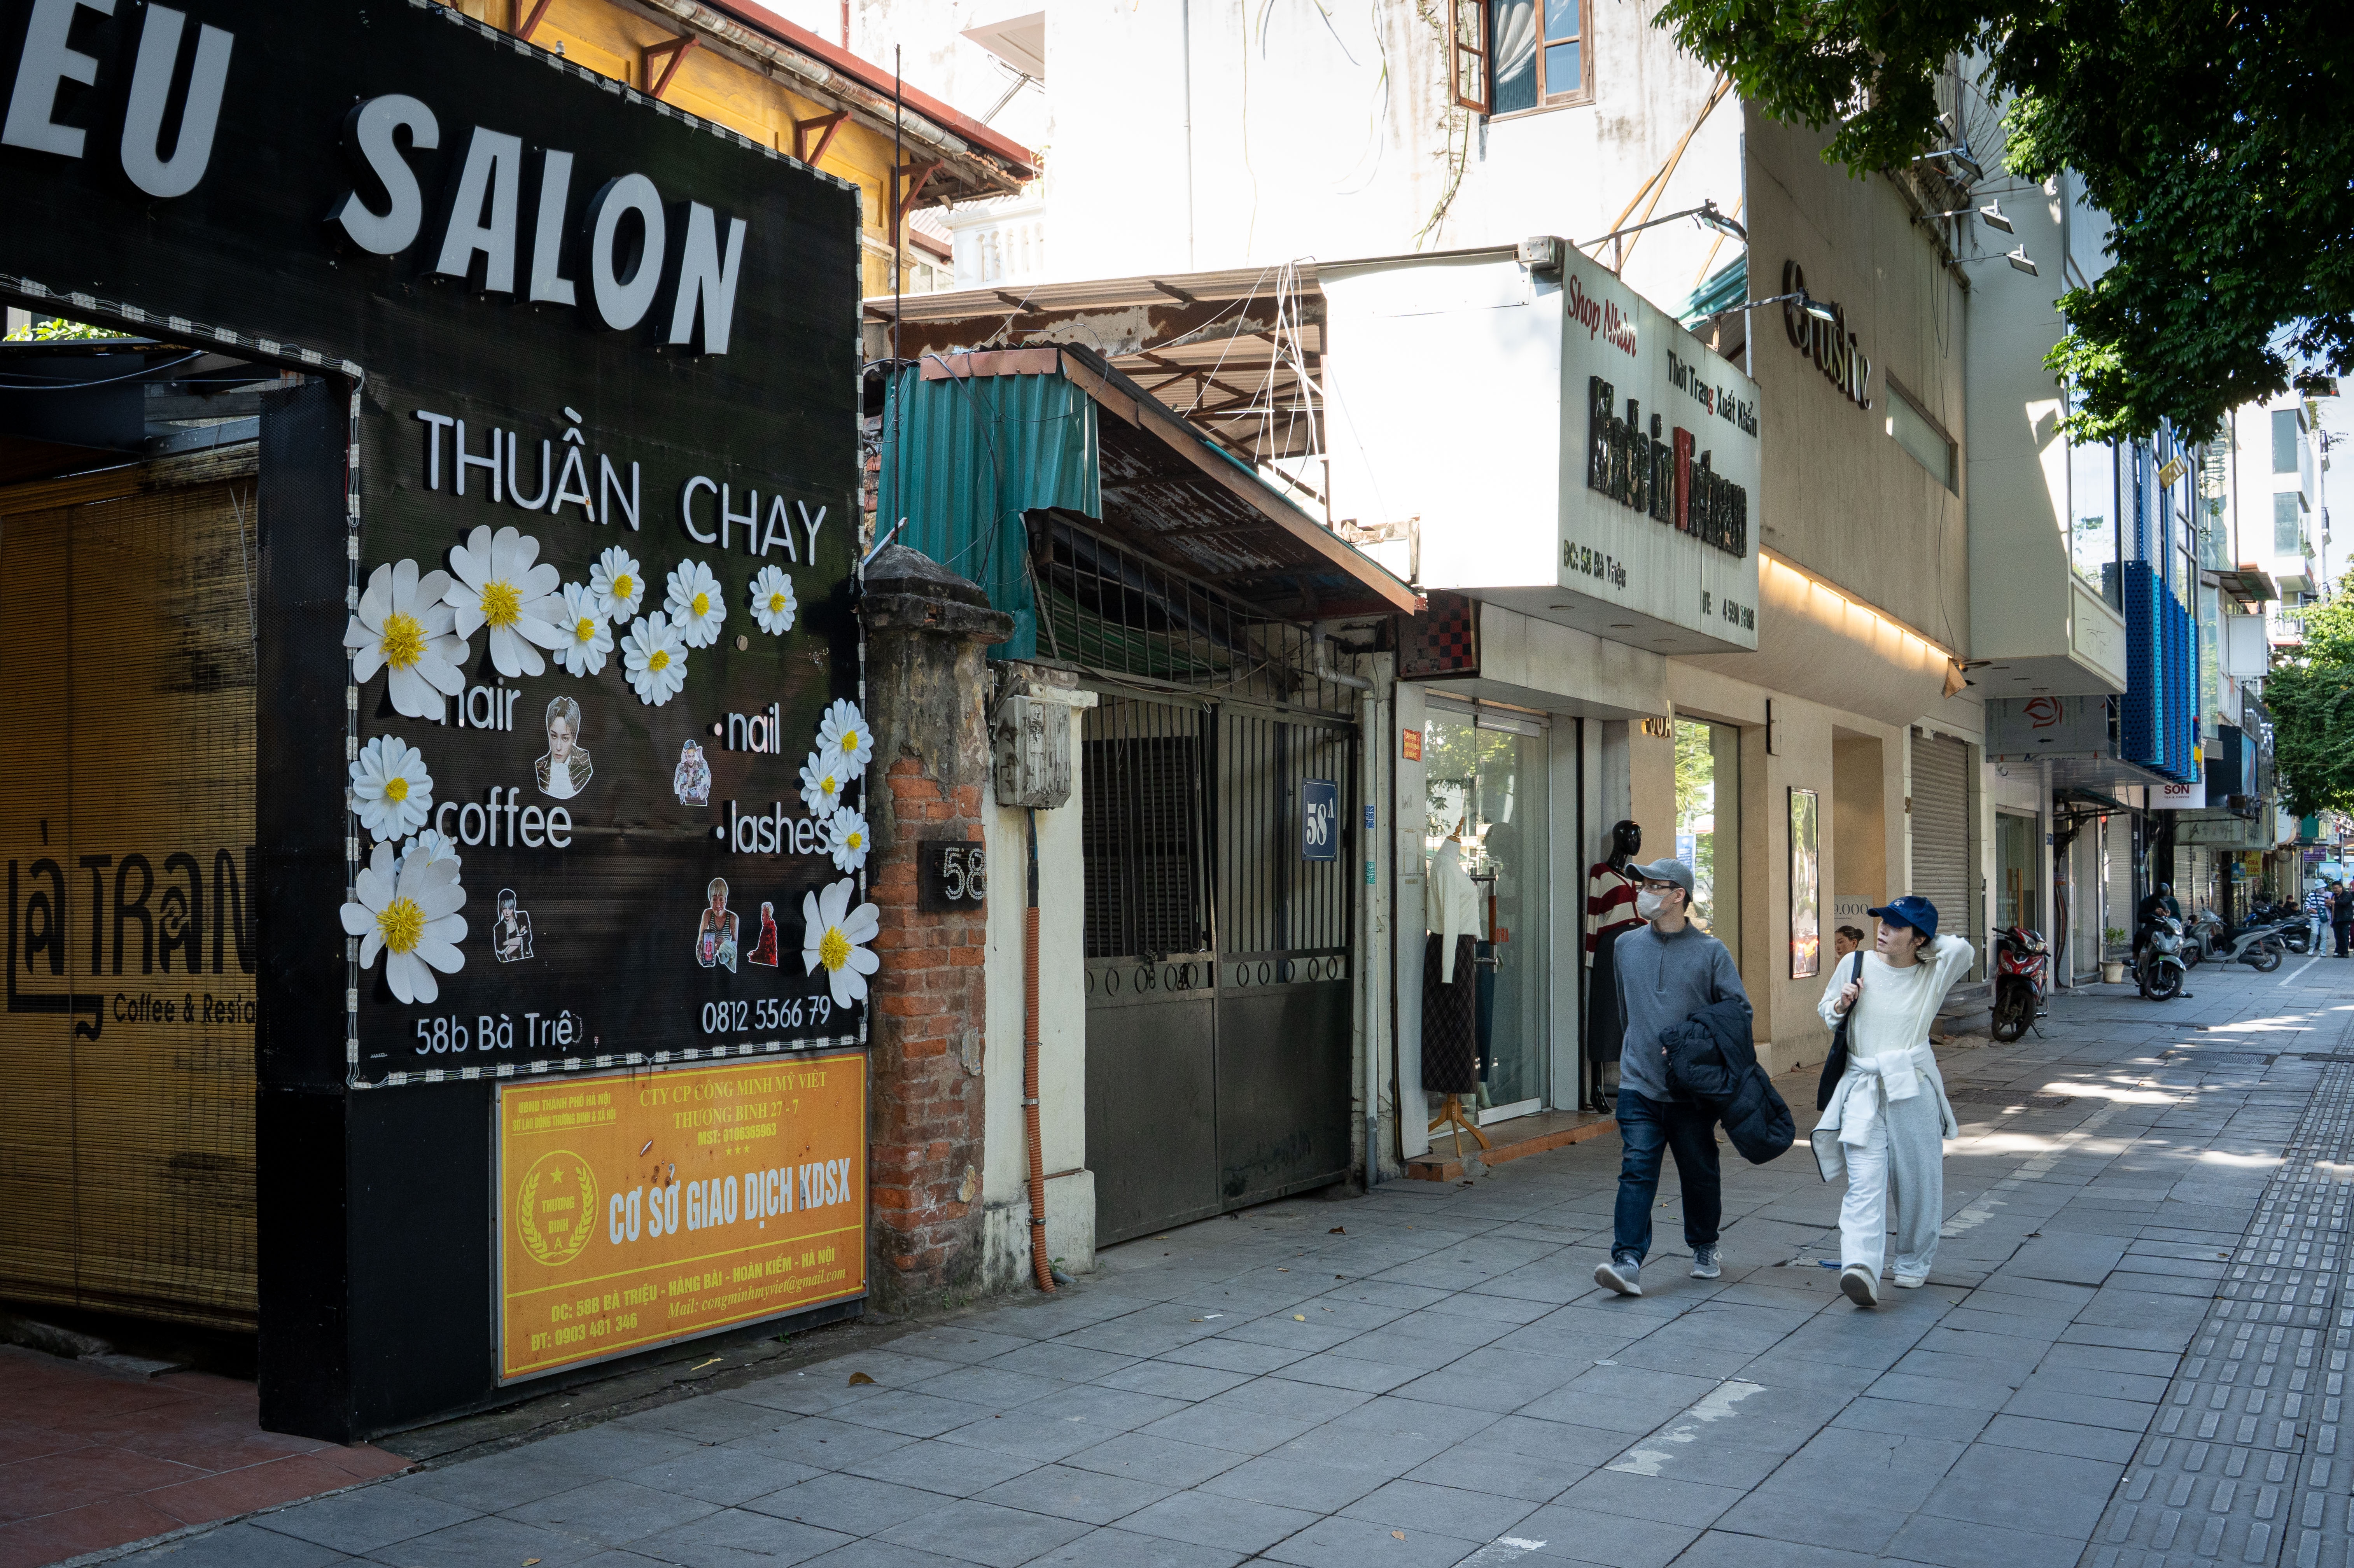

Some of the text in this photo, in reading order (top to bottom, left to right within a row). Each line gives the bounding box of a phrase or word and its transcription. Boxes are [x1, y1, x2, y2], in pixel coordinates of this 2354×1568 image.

[337, 94, 747, 356] SALON
[1568, 275, 1600, 340] Shop
[1668, 349, 1757, 438] Thời Trang Xuất Khẩu
[417, 407, 826, 566] THUẦN CHAY
[1581, 546, 1591, 574] 58
[1594, 551, 1604, 579] Bà
[1607, 555, 1626, 590] Triệu
[1723, 598, 1727, 621] 4
[729, 702, 780, 754] nail
[2164, 785, 2189, 794] SON
[436, 786, 572, 848] coffee
[732, 800, 830, 855] lashes
[943, 847, 987, 900] 58
[114, 992, 175, 1024] Coffee
[183, 993, 194, 1022] &
[702, 996, 831, 1033] 0812 5566 79
[416, 1014, 469, 1055] 58b
[479, 1013, 513, 1050] Bà
[518, 1091, 611, 1113] UBND THÀNH PHỐ HÀ NỘI
[640, 1069, 827, 1106] CTY CP CÔNG MINH MỸ VIỆT
[522, 1118, 533, 1130] LAO
[535, 1115, 551, 1130] ĐỘNG
[553, 1113, 575, 1127] THƯƠNG
[577, 1111, 590, 1124] BINH
[592, 1111, 596, 1122] &
[607, 1107, 616, 1122] HỘI
[673, 1107, 732, 1129] THƯƠNG
[736, 1102, 767, 1121] BINH
[771, 1101, 783, 1117] 27
[793, 1099, 799, 1114] 7
[698, 1123, 776, 1145] MST: 0106365963
[542, 1195, 575, 1213] THƯƠNG
[609, 1158, 851, 1245] CƠ SỞ GIAO DỊCH KDSX
[549, 1218, 569, 1234] BINH
[554, 1237, 563, 1250] A
[576, 1297, 600, 1317] 58B
[604, 1290, 620, 1311] BÀ
[623, 1283, 657, 1306] TRIỆU
[669, 1276, 700, 1297] HÀNG
[704, 1269, 722, 1290] BÀI
[733, 1262, 763, 1283] HOÀN
[765, 1253, 792, 1276] KIẾM
[802, 1249, 815, 1268] HÀ
[818, 1246, 835, 1266] NỘI
[667, 1269, 845, 1319] Mail: congminhmyviet@gmail.com
[531, 1312, 637, 1351] ĐT: 0903 481 346
